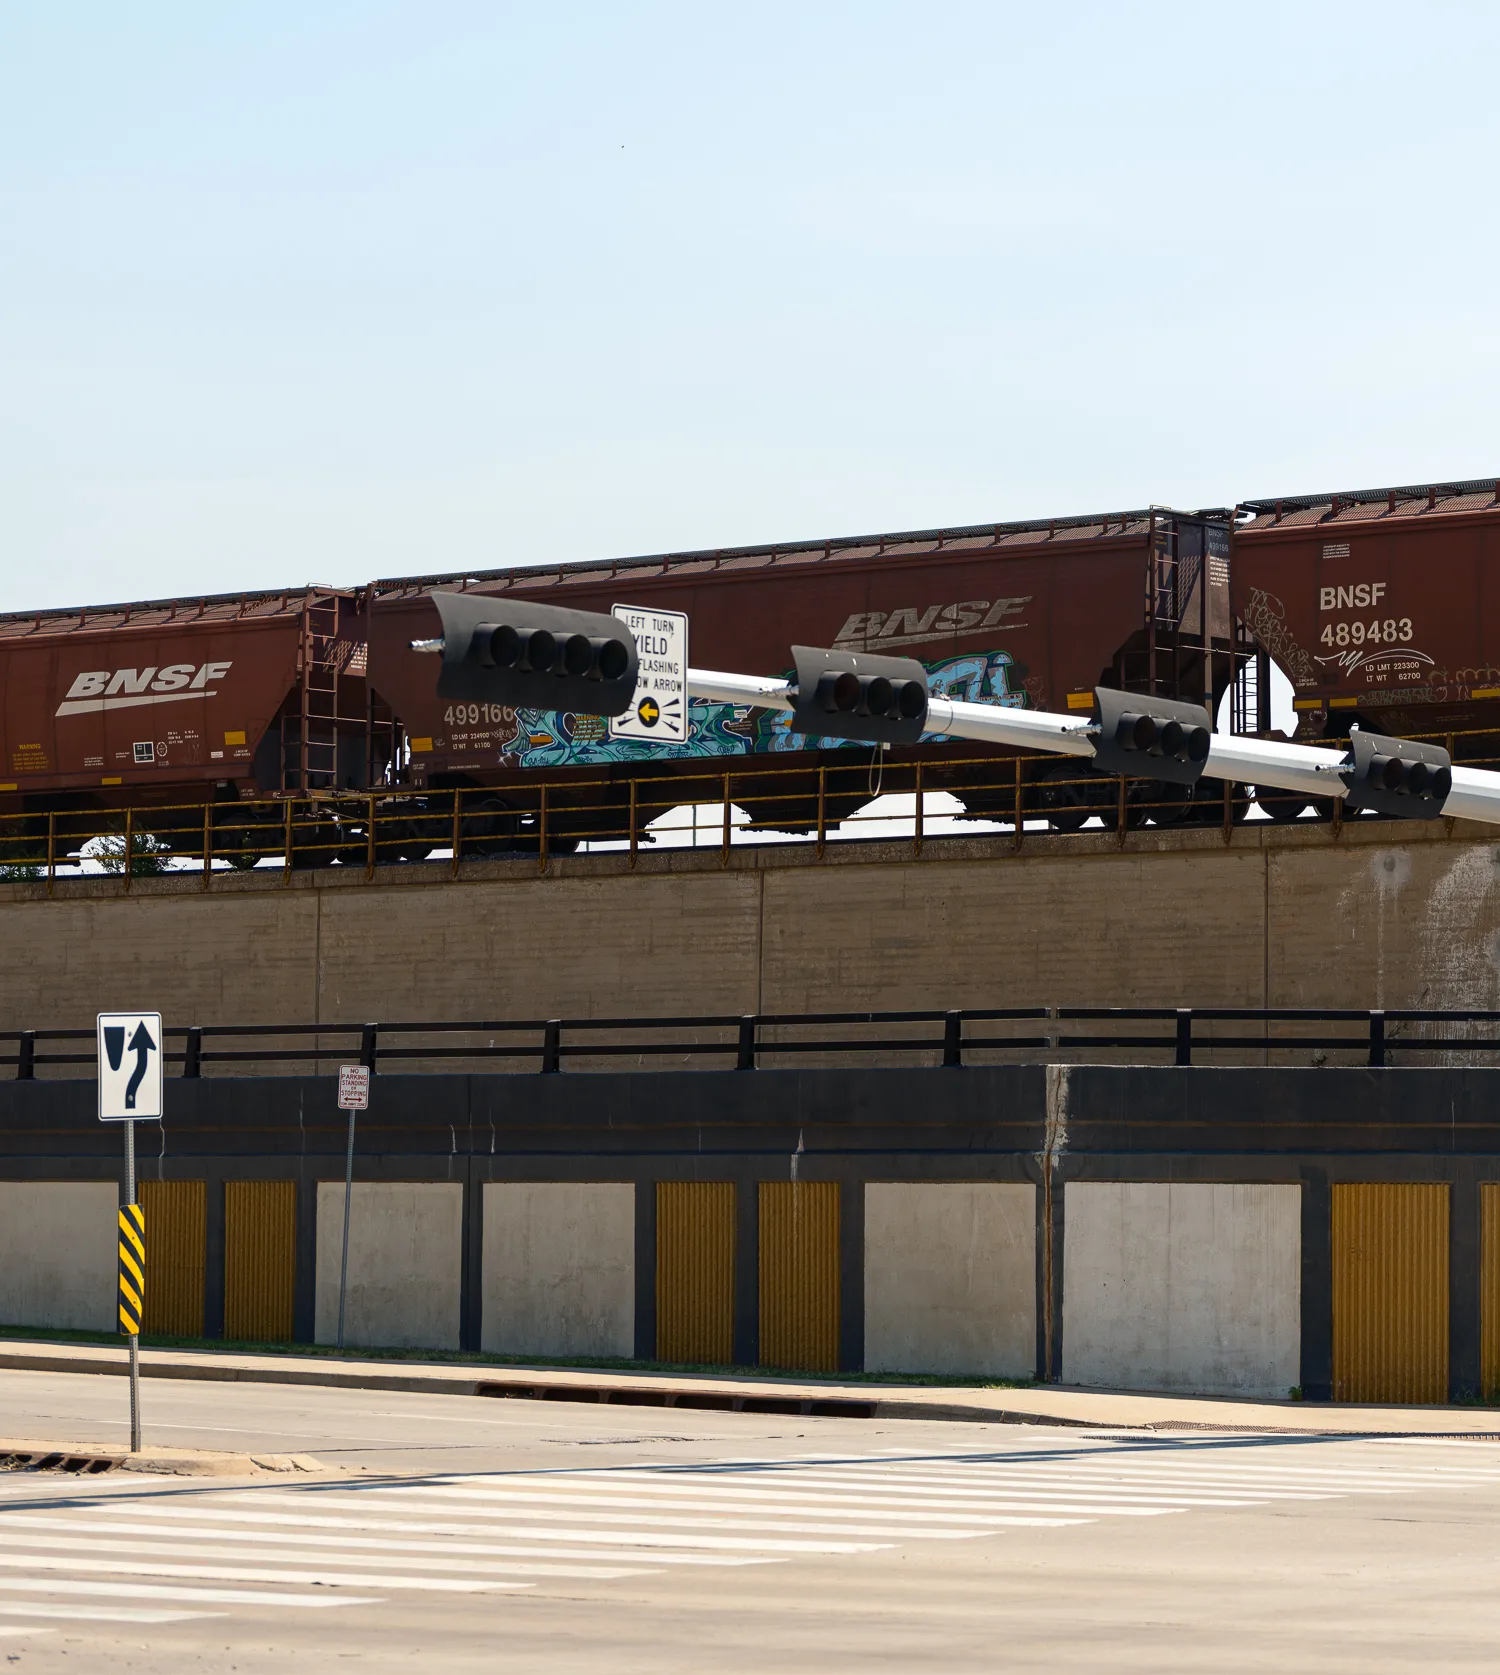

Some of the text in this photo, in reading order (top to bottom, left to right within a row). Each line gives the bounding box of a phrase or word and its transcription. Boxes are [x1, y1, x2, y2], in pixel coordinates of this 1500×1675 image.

[1320, 582, 1386, 610] BNSF
[625, 615, 674, 632] LEFT TURN
[834, 596, 1033, 642] BNSF
[1320, 618, 1413, 646] 489483
[633, 634, 667, 655] YIELD
[638, 659, 679, 674] FLASHING
[1378, 663, 1390, 671] LMT
[1393, 662, 1419, 670] 223300
[1399, 672, 1421, 680] 62700
[65, 661, 233, 698] BNSF
[654, 678, 683, 692] ARROW
[444, 704, 514, 726] 499166
